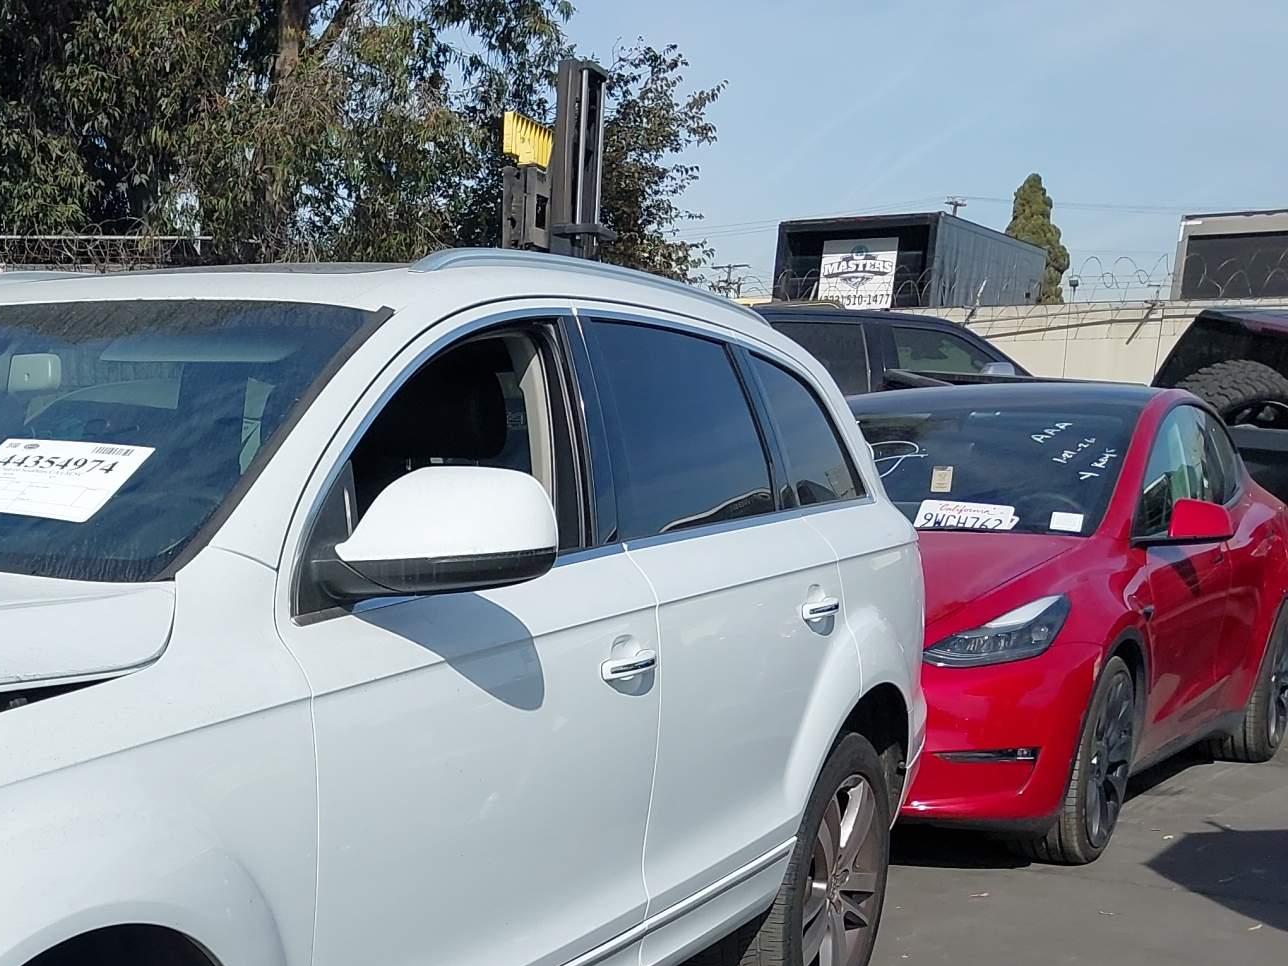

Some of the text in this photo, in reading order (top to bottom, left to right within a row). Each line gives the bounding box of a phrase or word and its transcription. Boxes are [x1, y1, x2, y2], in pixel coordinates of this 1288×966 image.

[823, 259, 894, 276] MASTERS
[846, 294, 890, 306] 510-1477
[1031, 422, 1073, 443] AAA
[939, 503, 991, 515] California
